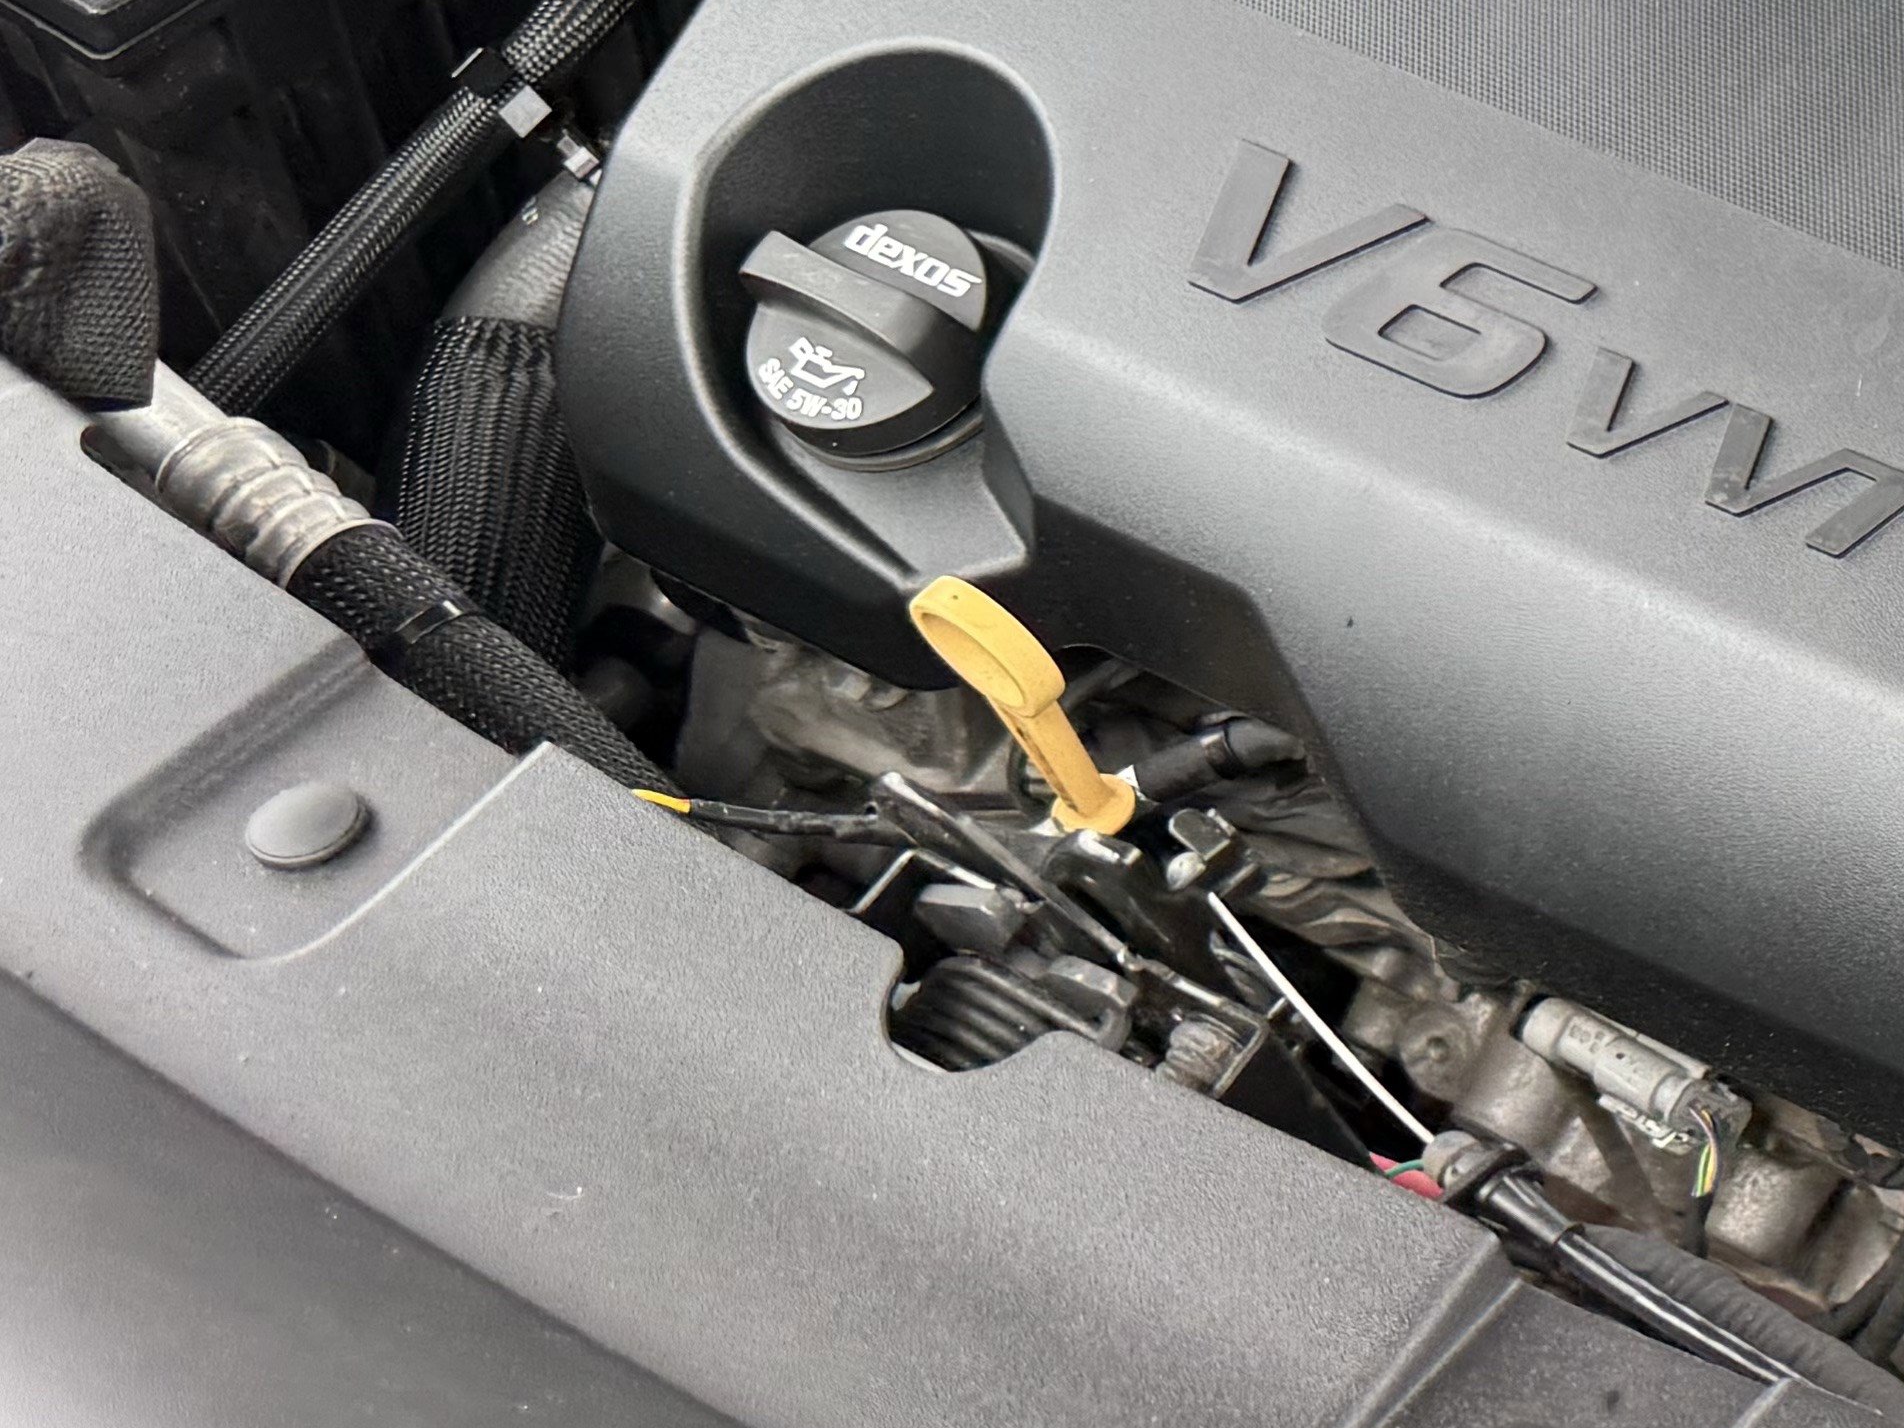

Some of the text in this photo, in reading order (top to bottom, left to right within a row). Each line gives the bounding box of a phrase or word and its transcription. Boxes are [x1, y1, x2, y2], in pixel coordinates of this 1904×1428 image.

[844, 222, 981, 299] dexos
[1188, 138, 1598, 401] V6
[757, 358, 862, 428] SAE 5W-30
